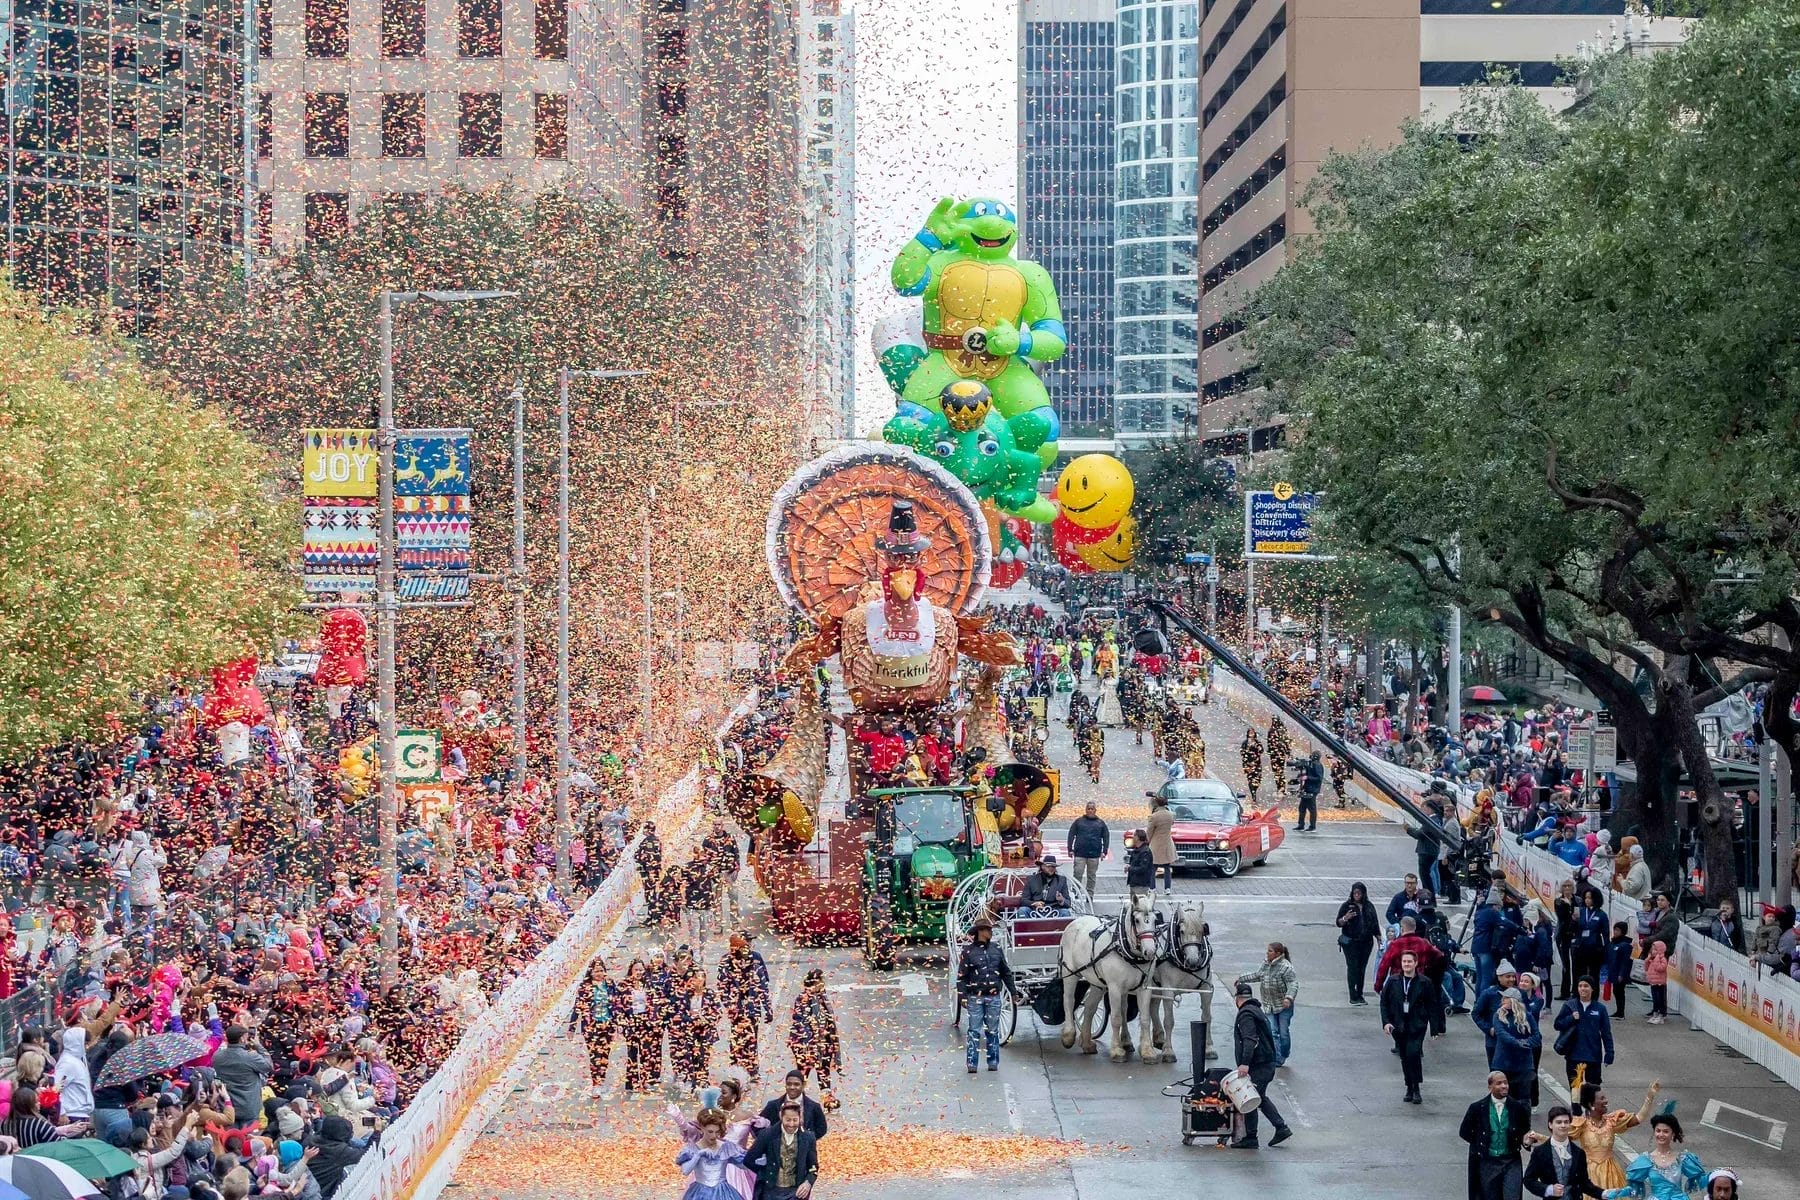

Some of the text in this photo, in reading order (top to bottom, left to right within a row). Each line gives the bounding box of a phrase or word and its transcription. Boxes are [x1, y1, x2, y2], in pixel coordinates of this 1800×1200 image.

[309, 453, 370, 482] JOY
[1255, 502, 1287, 510] Shopping
[875, 662, 929, 678] Thankful
[402, 743, 429, 769] C
